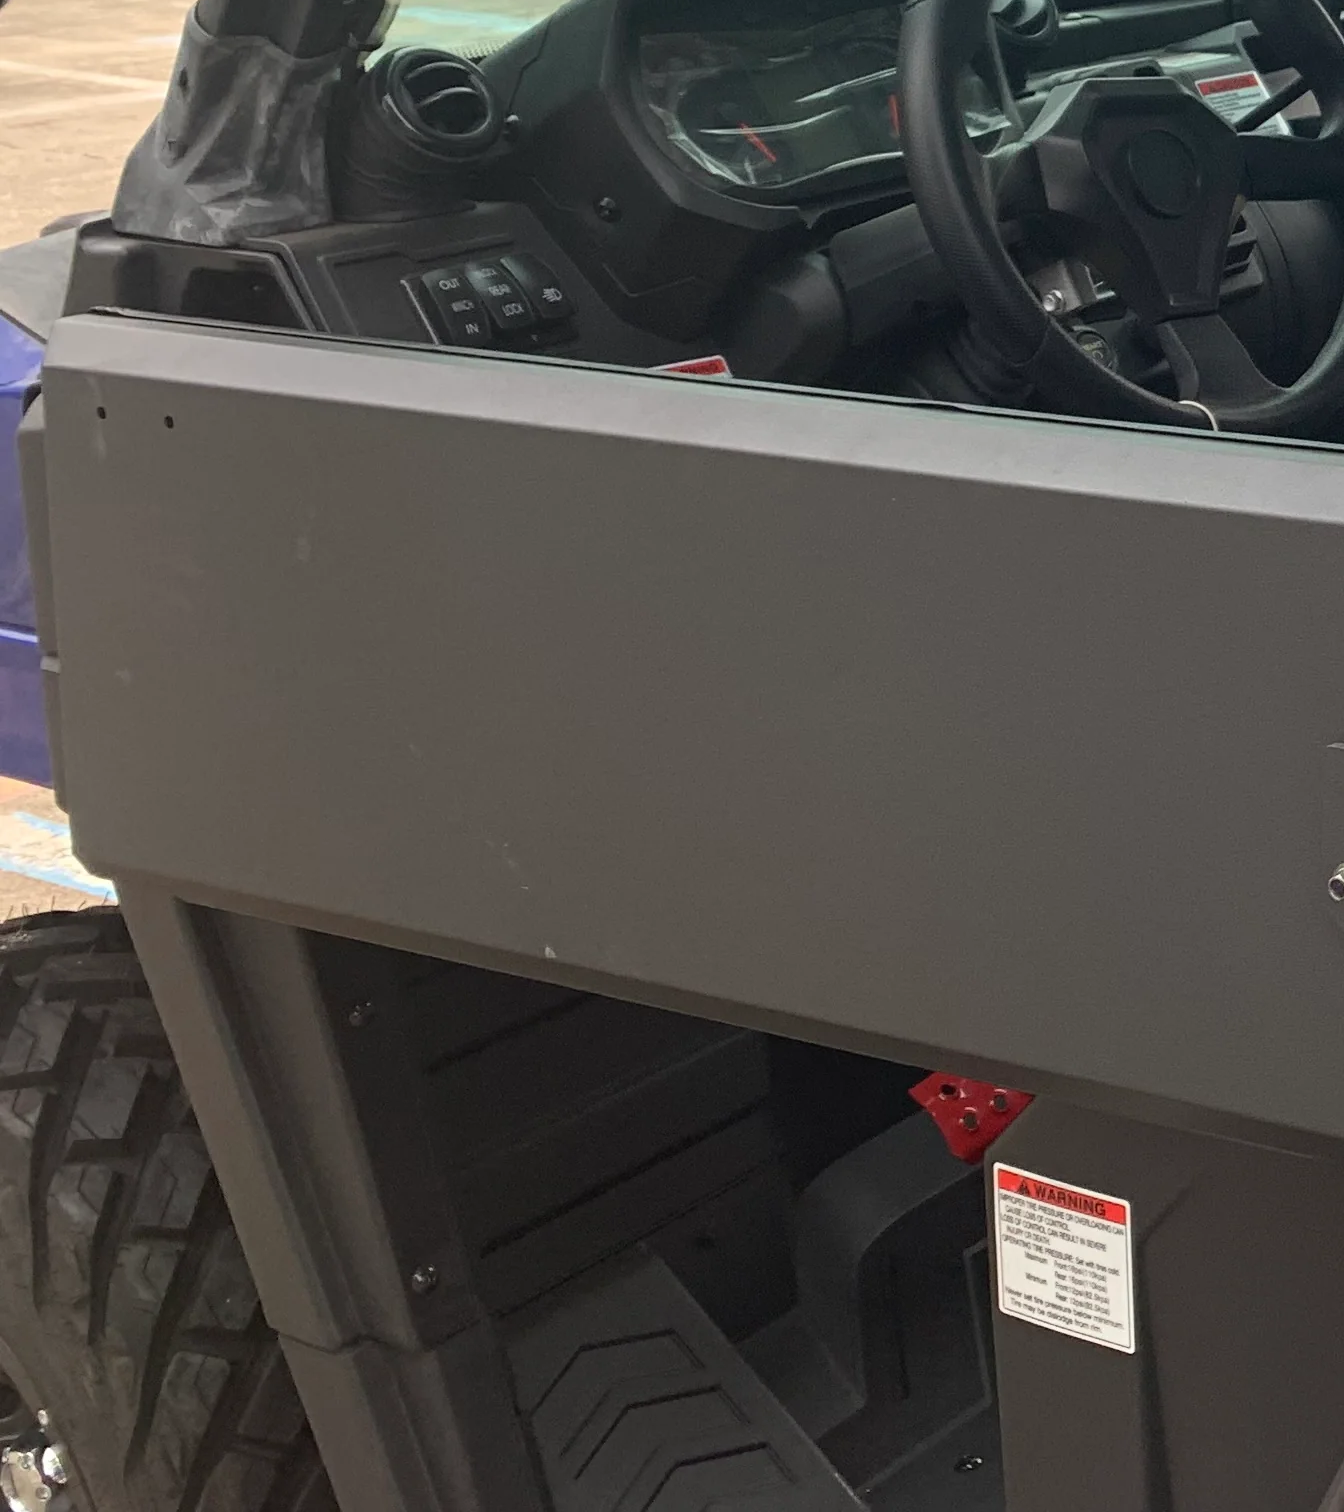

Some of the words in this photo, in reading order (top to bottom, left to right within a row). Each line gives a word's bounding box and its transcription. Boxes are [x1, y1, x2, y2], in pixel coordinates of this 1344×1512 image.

[439, 277, 460, 290] OUT
[502, 303, 525, 317] LOCK
[465, 324, 480, 334] IN
[1035, 1183, 1105, 1216] WARNING
